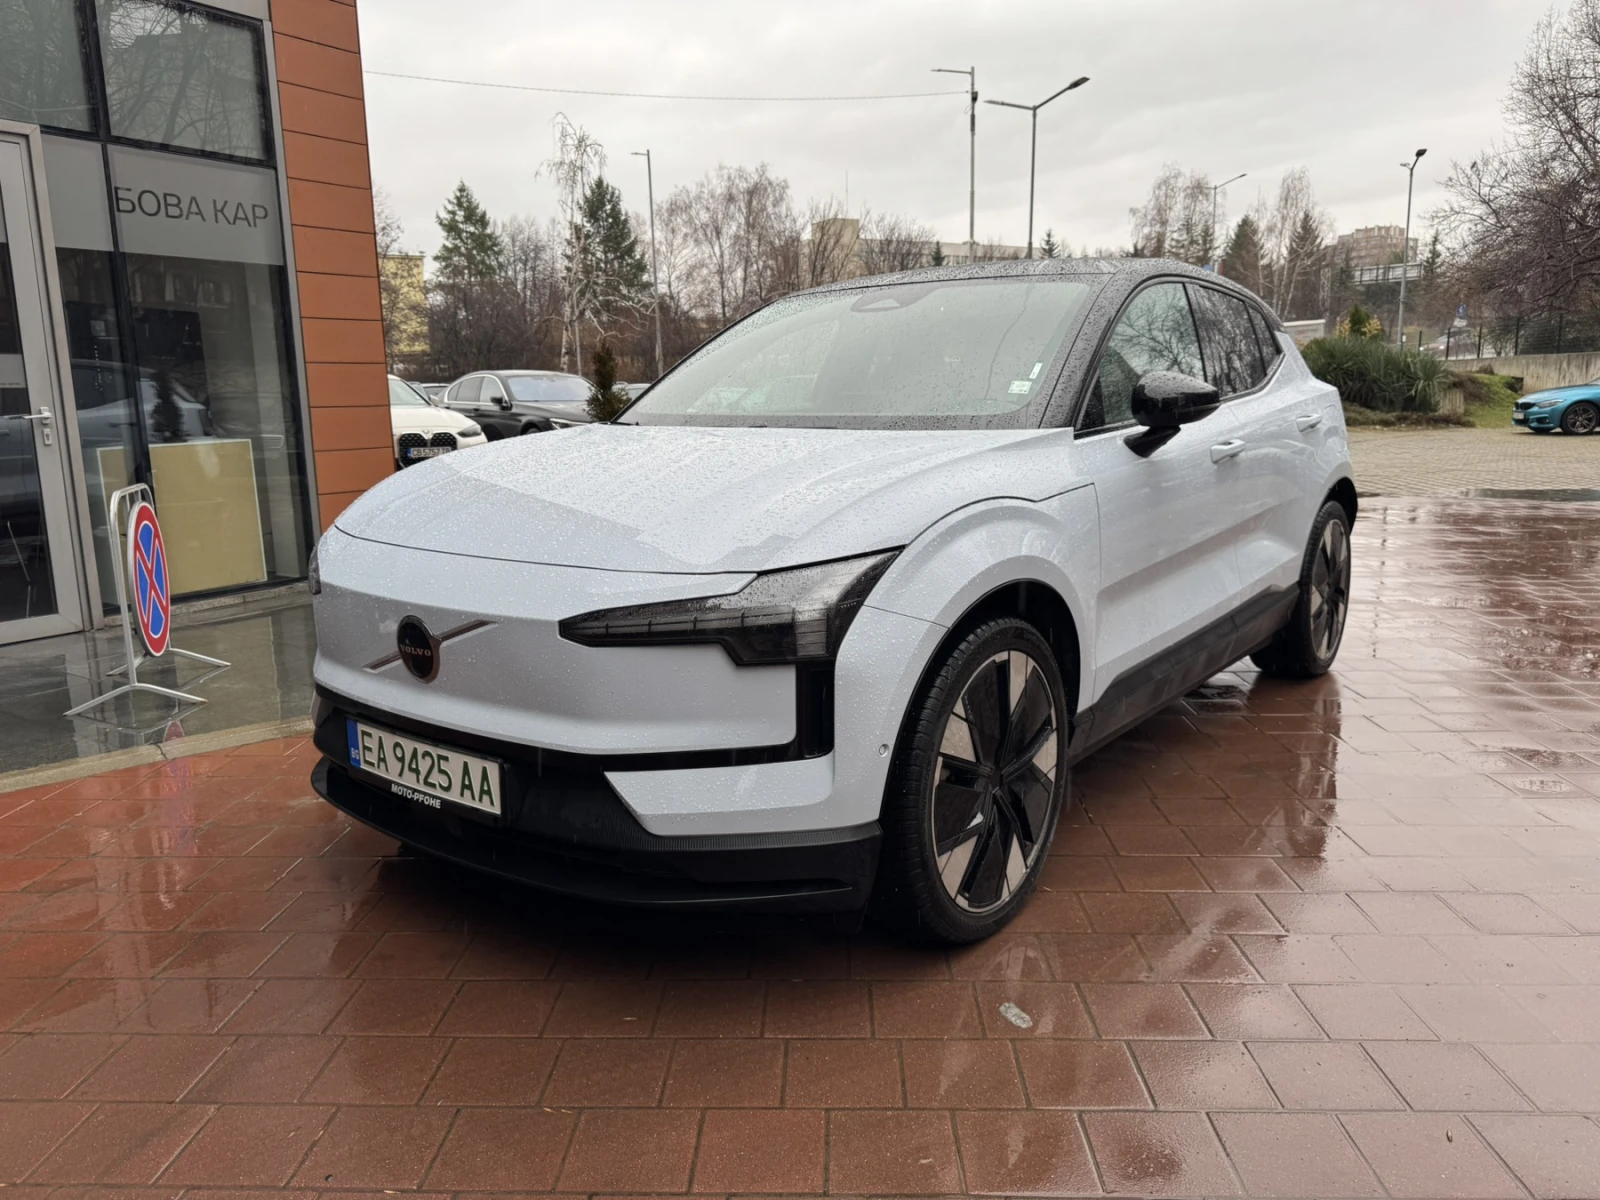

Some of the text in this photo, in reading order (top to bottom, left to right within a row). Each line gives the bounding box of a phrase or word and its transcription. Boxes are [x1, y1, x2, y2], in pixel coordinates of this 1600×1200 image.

[114, 185, 269, 228] БОВА КАР
[400, 644, 432, 657] VOLVO
[351, 747, 360, 760] BG
[361, 729, 496, 807] EA 9425 AA
[391, 783, 442, 809] MOTO-PFOHE
